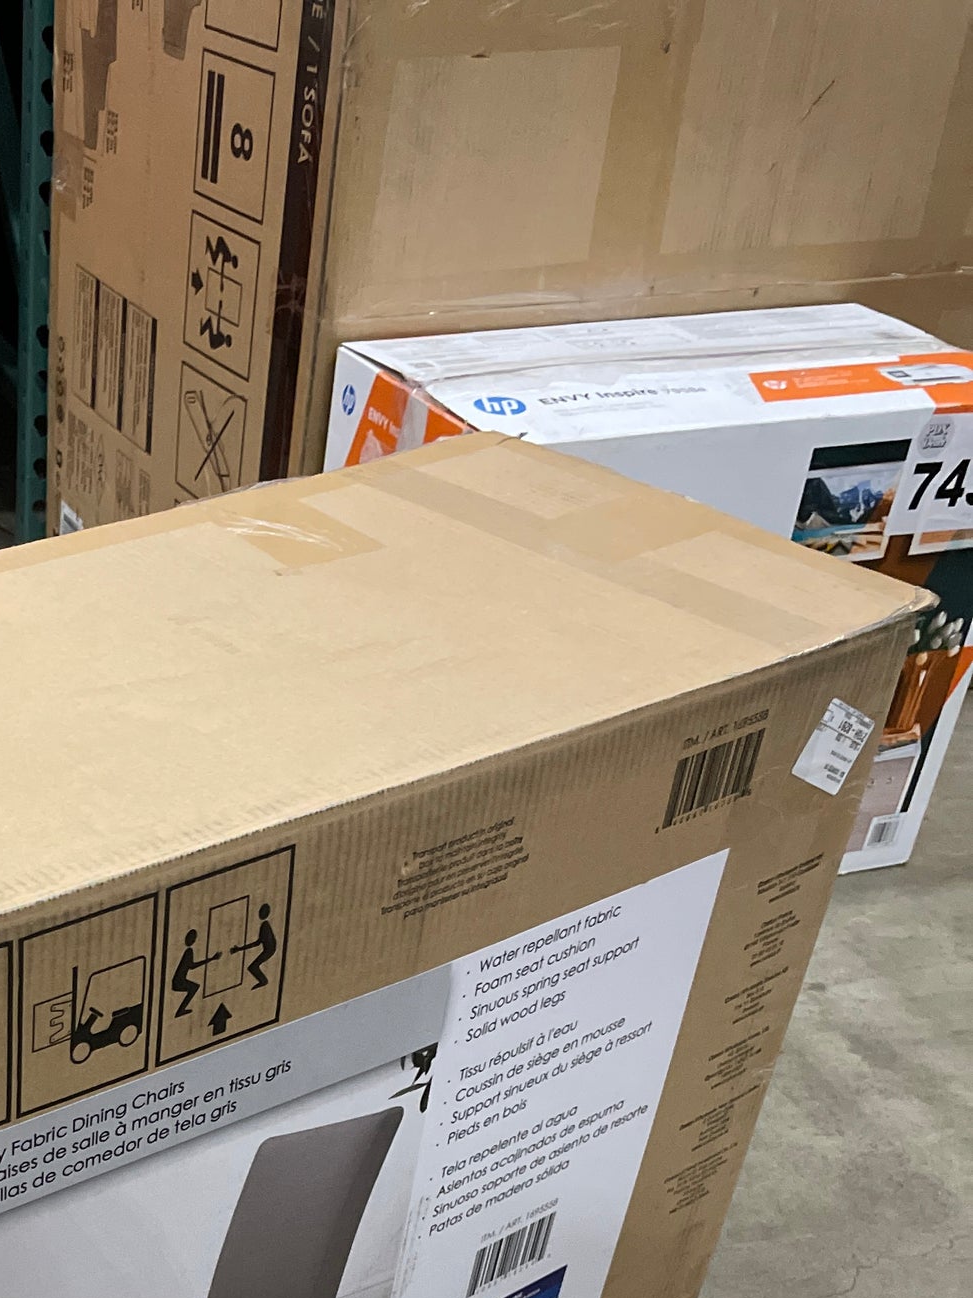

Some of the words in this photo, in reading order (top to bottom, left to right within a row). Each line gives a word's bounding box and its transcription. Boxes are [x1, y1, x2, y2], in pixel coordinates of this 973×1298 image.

[231, 123, 253, 161] 8
[479, 396, 523, 416] hp
[538, 392, 591, 405] ENVY
[596, 387, 658, 401] Inspire
[908, 459, 973, 510] 74
[475, 973, 512, 996] Foam
[515, 957, 544, 979] seat
[547, 938, 595, 965] cushion
[481, 947, 520, 972] Water
[523, 920, 581, 954] repellant
[585, 906, 621, 928] fabric
[470, 991, 519, 1019] Sinuous
[522, 973, 560, 997] spring
[563, 958, 590, 980] seat
[592, 937, 639, 967] support
[460, 1062, 486, 1080] Tissu
[489, 1037, 534, 1067] répulsif
[536, 1033, 545, 1046] à
[548, 1021, 577, 1041] l'eau
[466, 1018, 497, 1042] Solid
[501, 1000, 538, 1026] wood
[540, 991, 566, 1009] legs
[451, 1091, 500, 1124] Support
[503, 1072, 548, 1100] sinueux
[552, 1063, 568, 1077] du
[571, 1047, 602, 1068] siège
[605, 1039, 613, 1052] à
[616, 1022, 652, 1047] ressort
[456, 1074, 503, 1101] Coussin
[507, 1065, 523, 1078] de
[527, 1048, 559, 1070] siège
[563, 1039, 578, 1053] en
[581, 1018, 625, 1044] mousse
[12, 1126, 67, 1155] Fabric
[73, 1104, 127, 1133] Dining
[132, 1082, 184, 1109] Chairs
[32, 1172, 56, 1188] de
[63, 1137, 143, 1176] comedor
[147, 1128, 169, 1144] de
[175, 1113, 206, 1133] tela
[211, 1101, 236, 1122] gris
[43, 1147, 66, 1163] de
[72, 1131, 110, 1153] salle
[115, 1122, 126, 1136] à
[132, 1096, 199, 1130] manger
[204, 1087, 224, 1102] en
[229, 1073, 261, 1093] tissu
[266, 1060, 291, 1082] gris
[442, 1160, 466, 1178] Tela
[469, 1130, 528, 1165] repelente
[532, 1120, 543, 1134] al
[546, 1106, 578, 1128] agua
[448, 1122, 480, 1144] Pieds
[483, 1113, 499, 1127] en
[503, 1099, 527, 1118] bois
[433, 1189, 478, 1217] Sinuoso
[481, 1165, 526, 1193] soporte
[530, 1156, 545, 1169] de
[549, 1134, 590, 1160] asiento
[593, 1125, 608, 1138] de
[611, 1105, 648, 1129] resorte
[437, 1167, 487, 1198] Asientos
[490, 1133, 556, 1171] acojinados
[560, 1125, 575, 1138] de
[578, 1100, 624, 1129] espuma
[429, 1213, 463, 1236] Patas
[466, 1204, 482, 1217] de
[485, 1178, 533, 1208] madera
[536, 1160, 569, 1183] sólida
